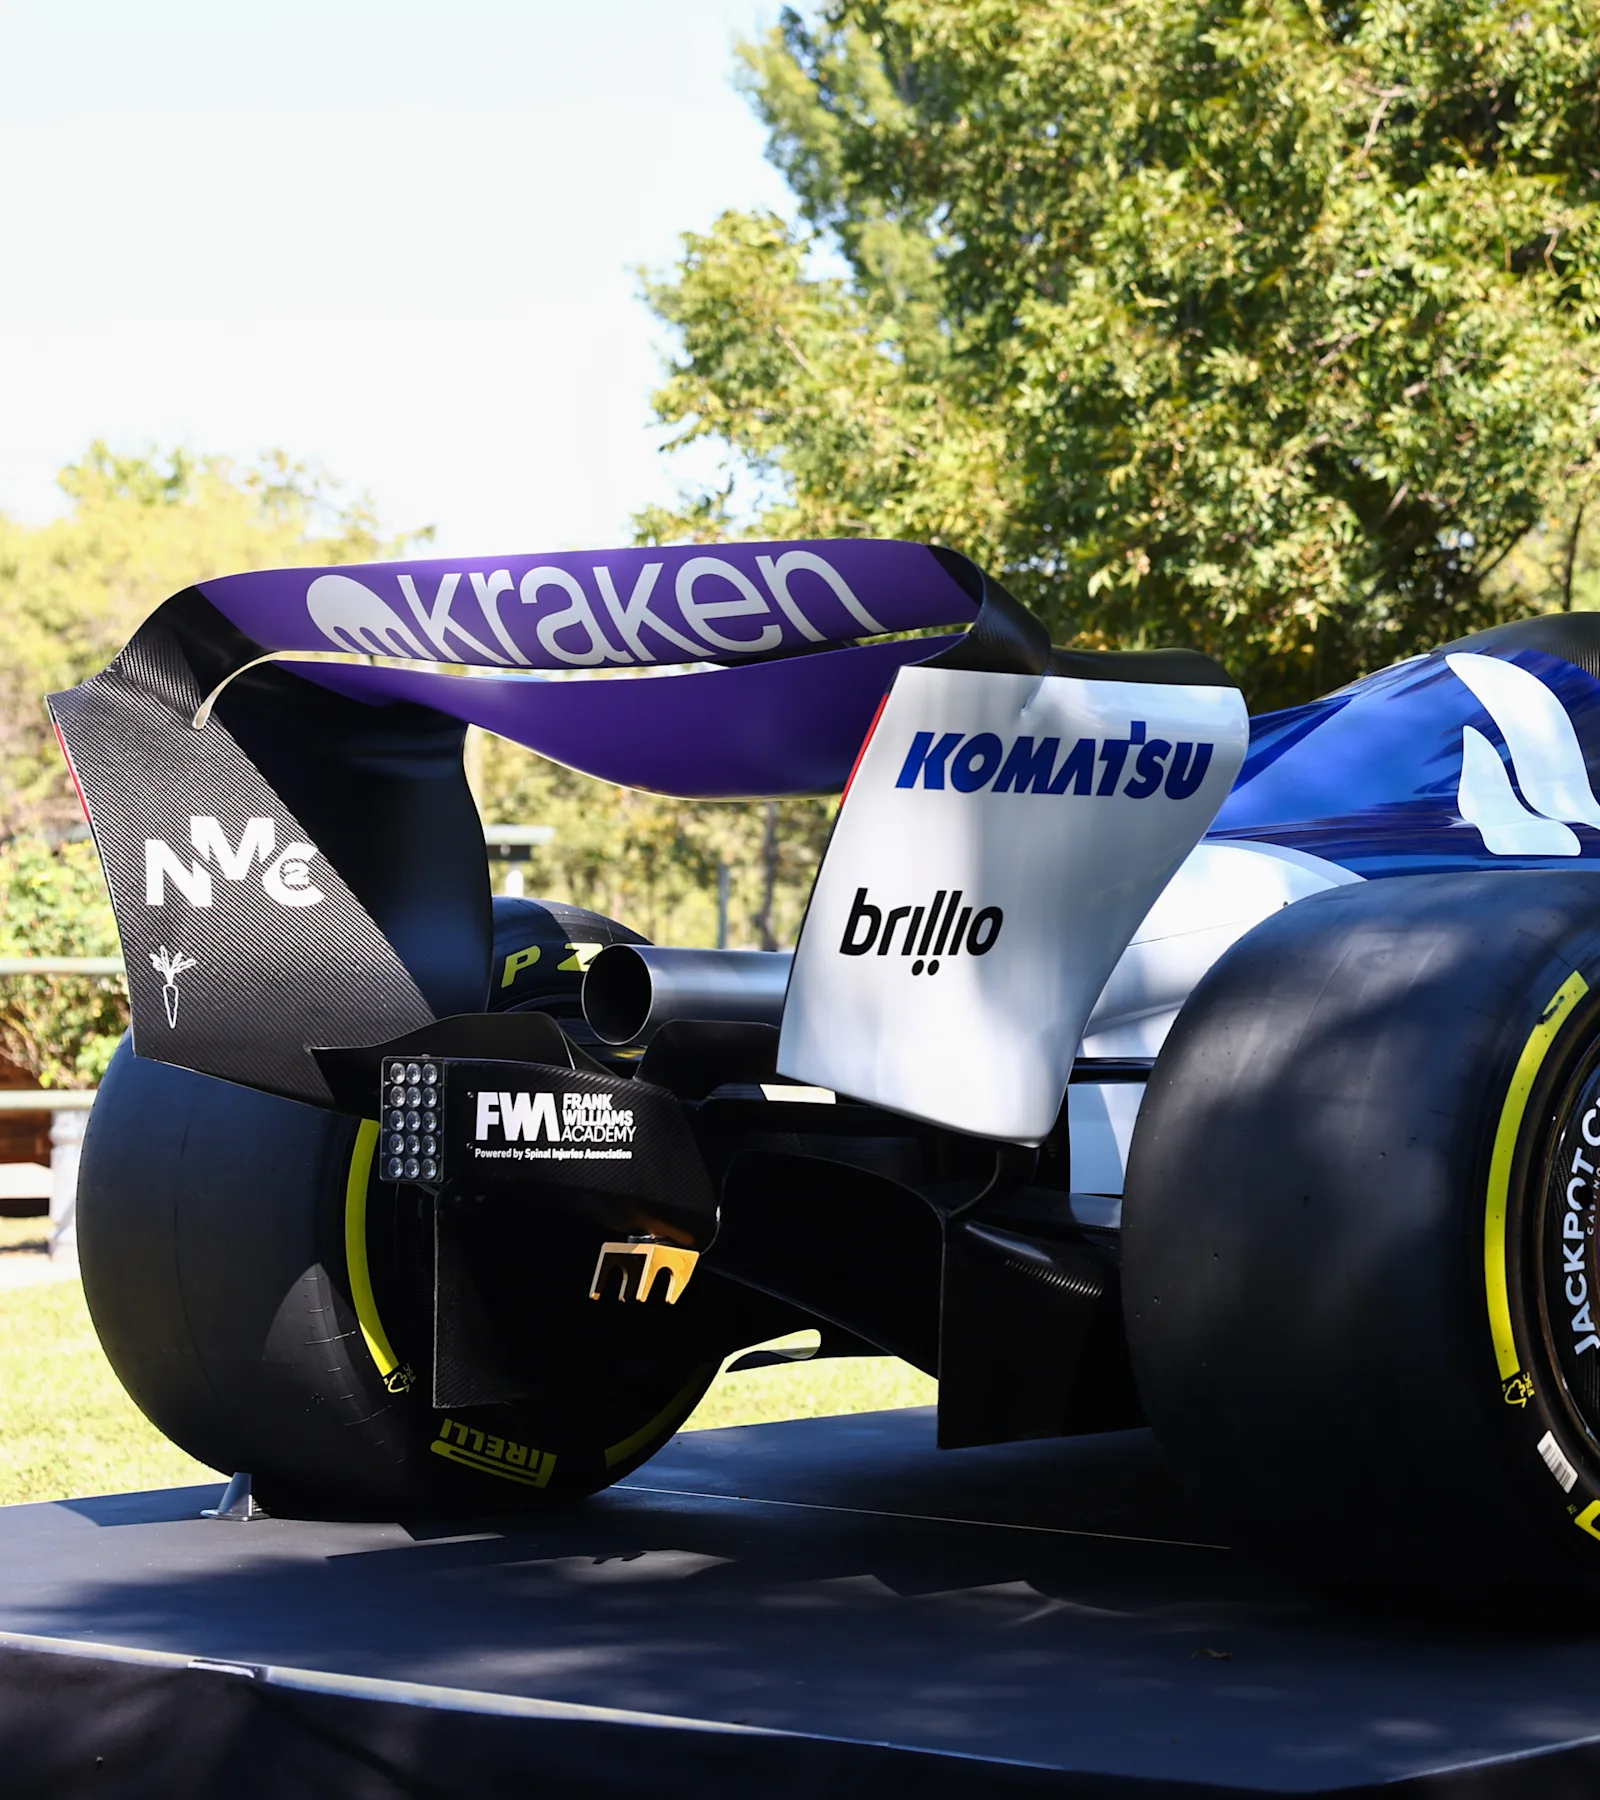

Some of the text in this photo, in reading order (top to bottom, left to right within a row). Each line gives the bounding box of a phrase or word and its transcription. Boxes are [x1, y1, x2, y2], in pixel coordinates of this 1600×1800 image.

[401, 550, 891, 667] kraken
[895, 720, 1213, 800] KOMATSU
[839, 887, 1003, 976] brillio
[501, 945, 541, 988] P
[562, 1109, 634, 1126] WILLIAMS
[563, 1093, 613, 1110] FRANK
[475, 1149, 632, 1161] Powered by Spinal Injuries Association
[561, 1125, 637, 1142] ACADEMY
[1563, 1147, 1600, 1356] JACKPOT
[430, 1418, 557, 1488] PIRELLI
